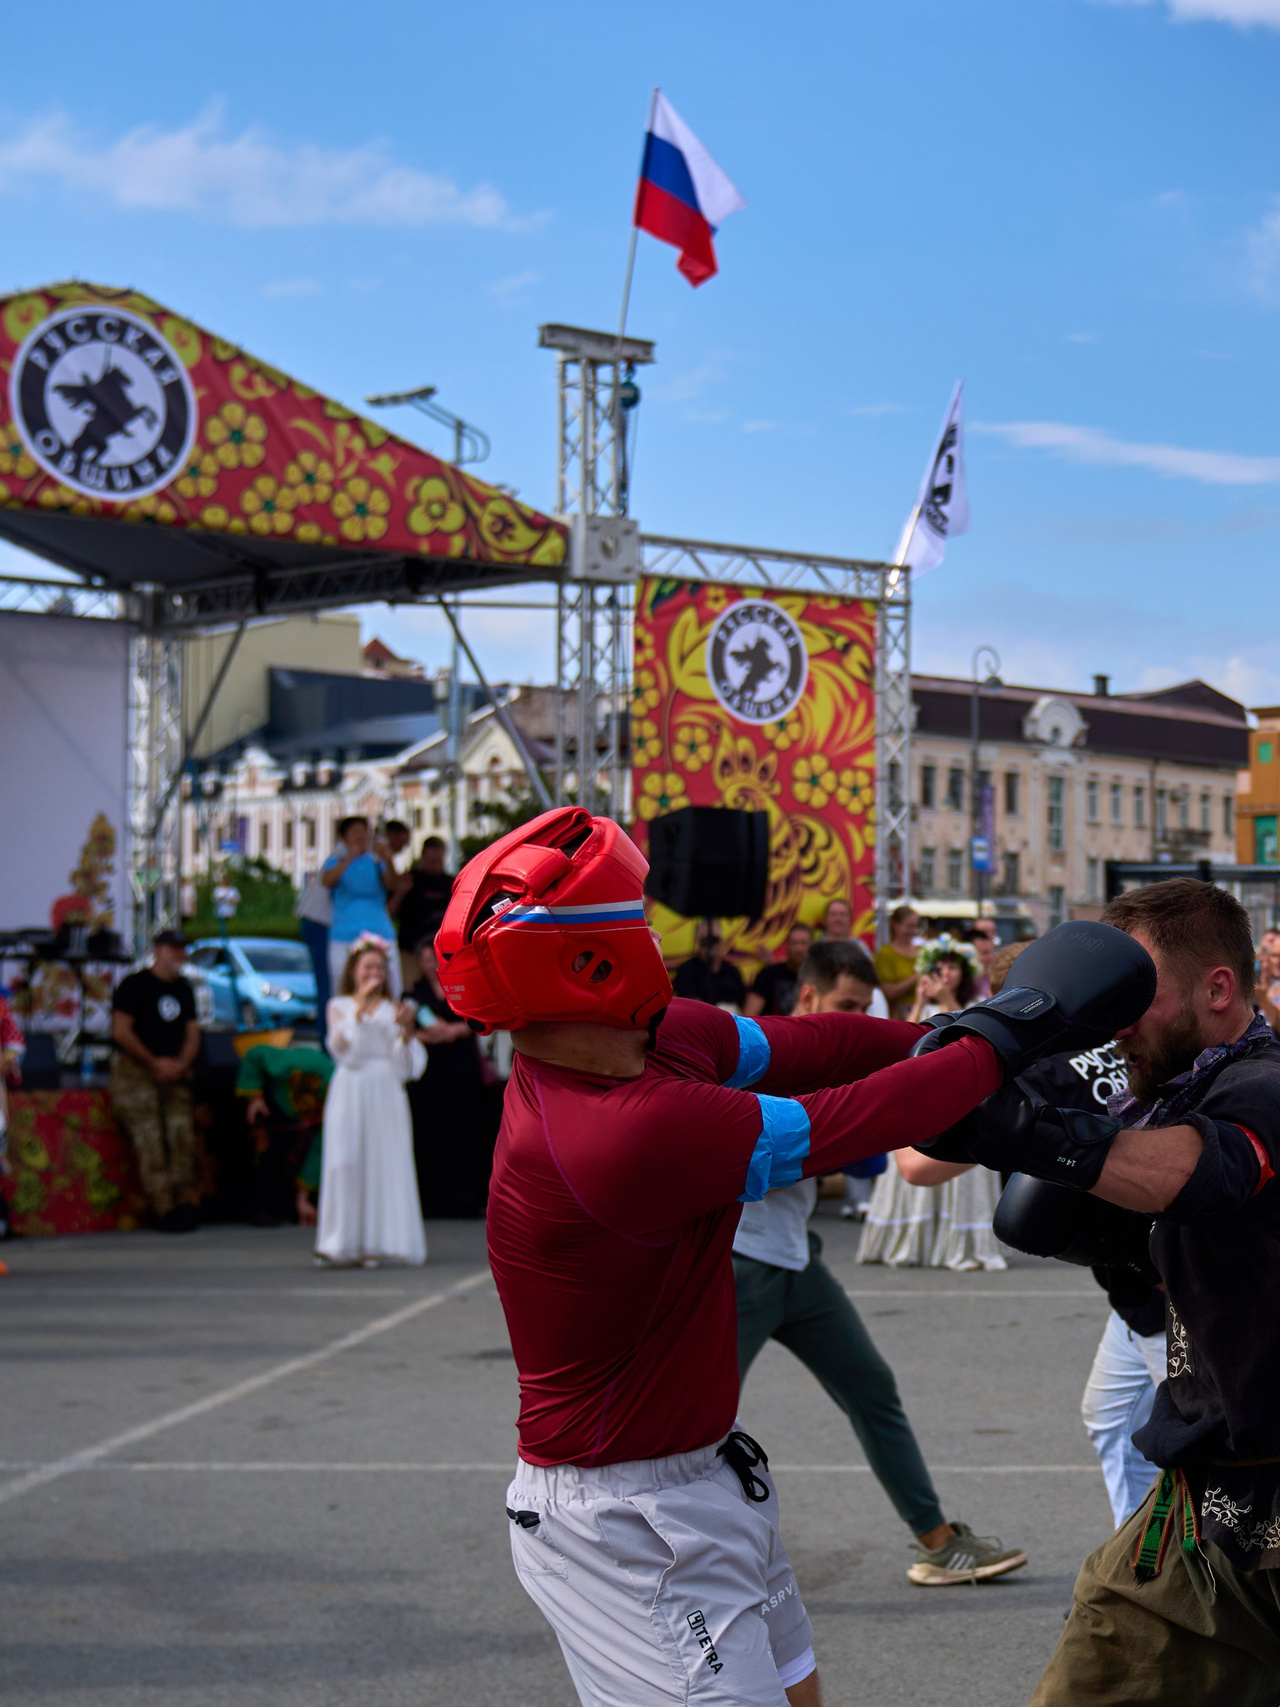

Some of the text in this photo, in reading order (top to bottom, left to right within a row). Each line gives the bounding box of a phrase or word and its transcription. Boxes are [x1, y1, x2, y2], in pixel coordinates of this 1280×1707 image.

[29, 317, 181, 386] РУССКАЯ
[34, 429, 174, 491] ОБЩИНА
[718, 606, 798, 648] РУССКАЯ
[720, 681, 795, 718] ОБЩИНА
[1069, 1040, 1126, 1080] РУСС
[1092, 1068, 1129, 1105] ОБ
[1066, 1159, 1077, 1167] 14
[760, 1583, 794, 1615] ASRV
[696, 1626, 724, 1675] TETRA
